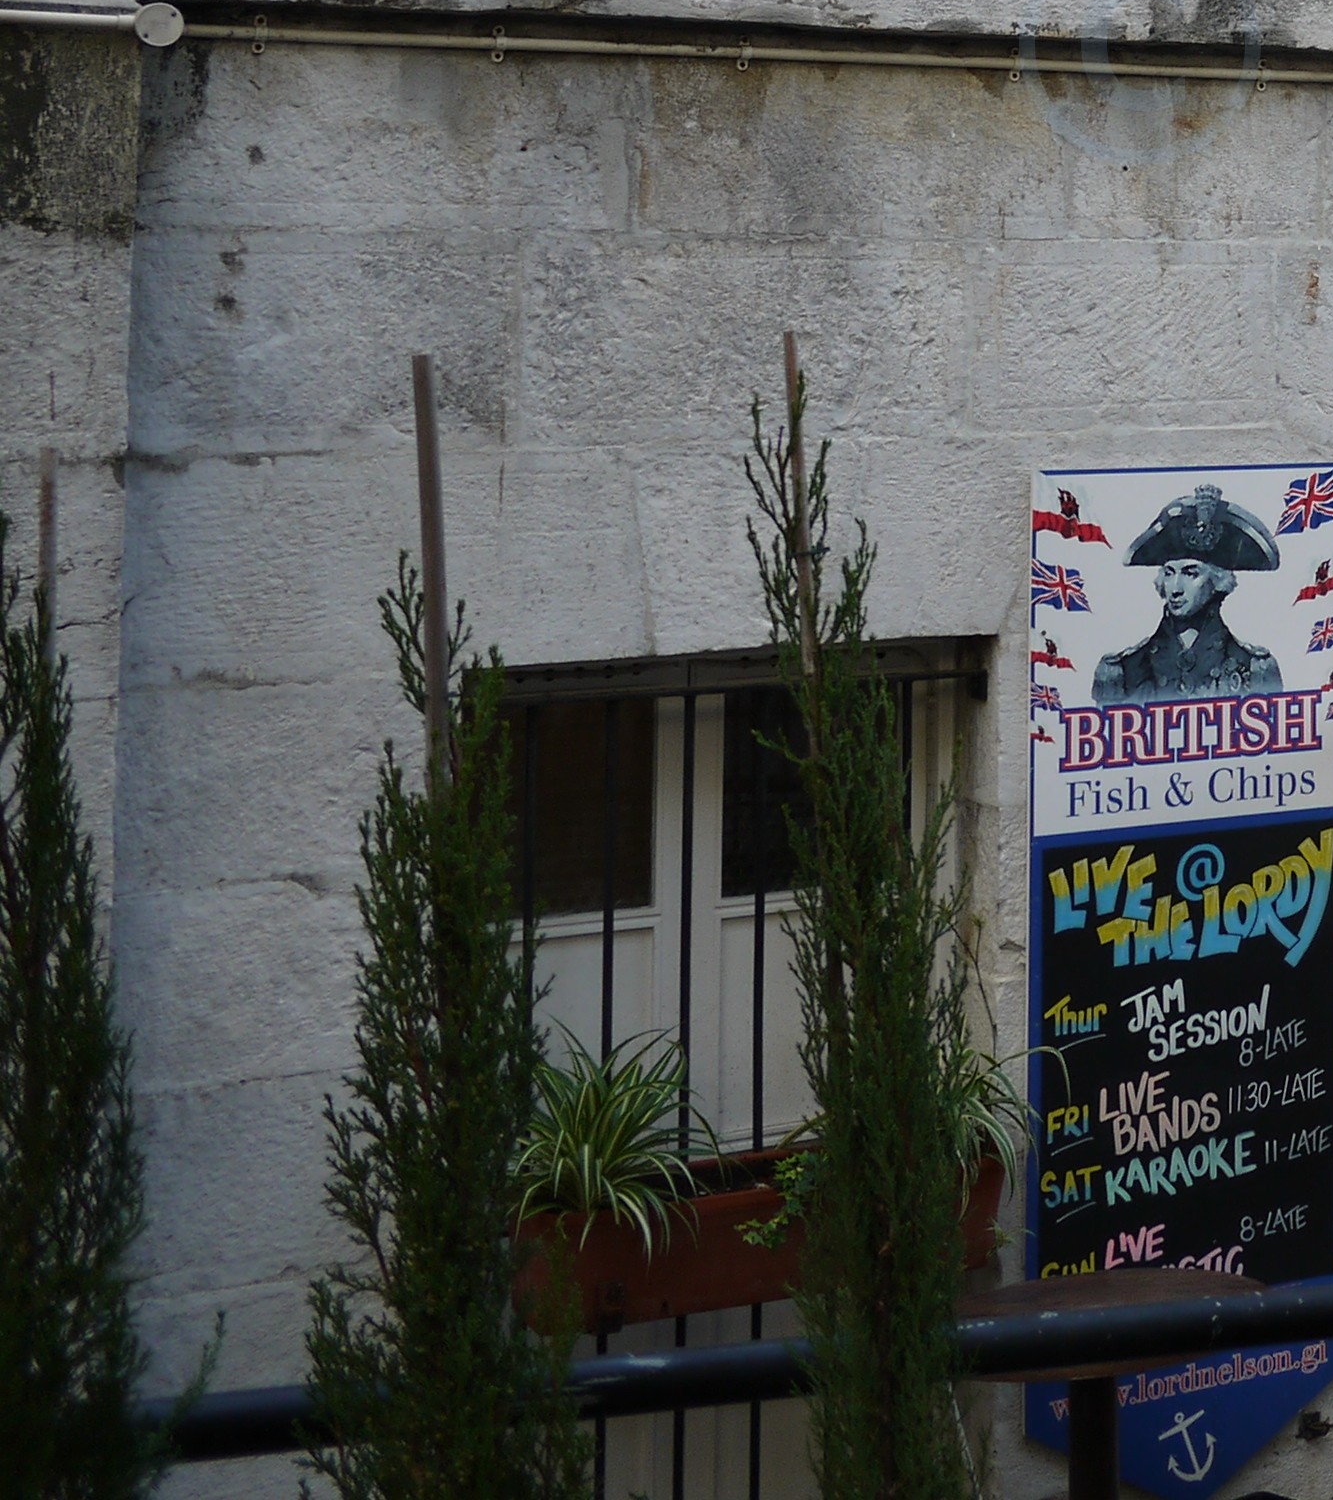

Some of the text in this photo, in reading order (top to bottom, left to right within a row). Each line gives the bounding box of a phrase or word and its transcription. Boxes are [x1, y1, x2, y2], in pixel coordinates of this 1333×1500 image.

[1060, 690, 1322, 773] BRITISH
[1066, 764, 1316, 819] Fish & Chips
[1048, 843, 1225, 935] LIVE @
[1097, 894, 1197, 968] THE
[1044, 978, 1186, 1037] Thur JAM
[1148, 984, 1271, 1063] SESSION
[1239, 1019, 1307, 1067] 8-LATE
[1046, 1104, 1090, 1145] FRI
[1099, 1071, 1171, 1124] LIVE
[1112, 1091, 1223, 1156] BANDS
[1040, 1124, 1333, 1209] SAT KARAOKE 11-LATE
[1104, 1223, 1167, 1271] LIVE
[1239, 1204, 1310, 1243] 8-LATE
[1049, 1339, 1329, 1422] ww.lordnelson.gi
